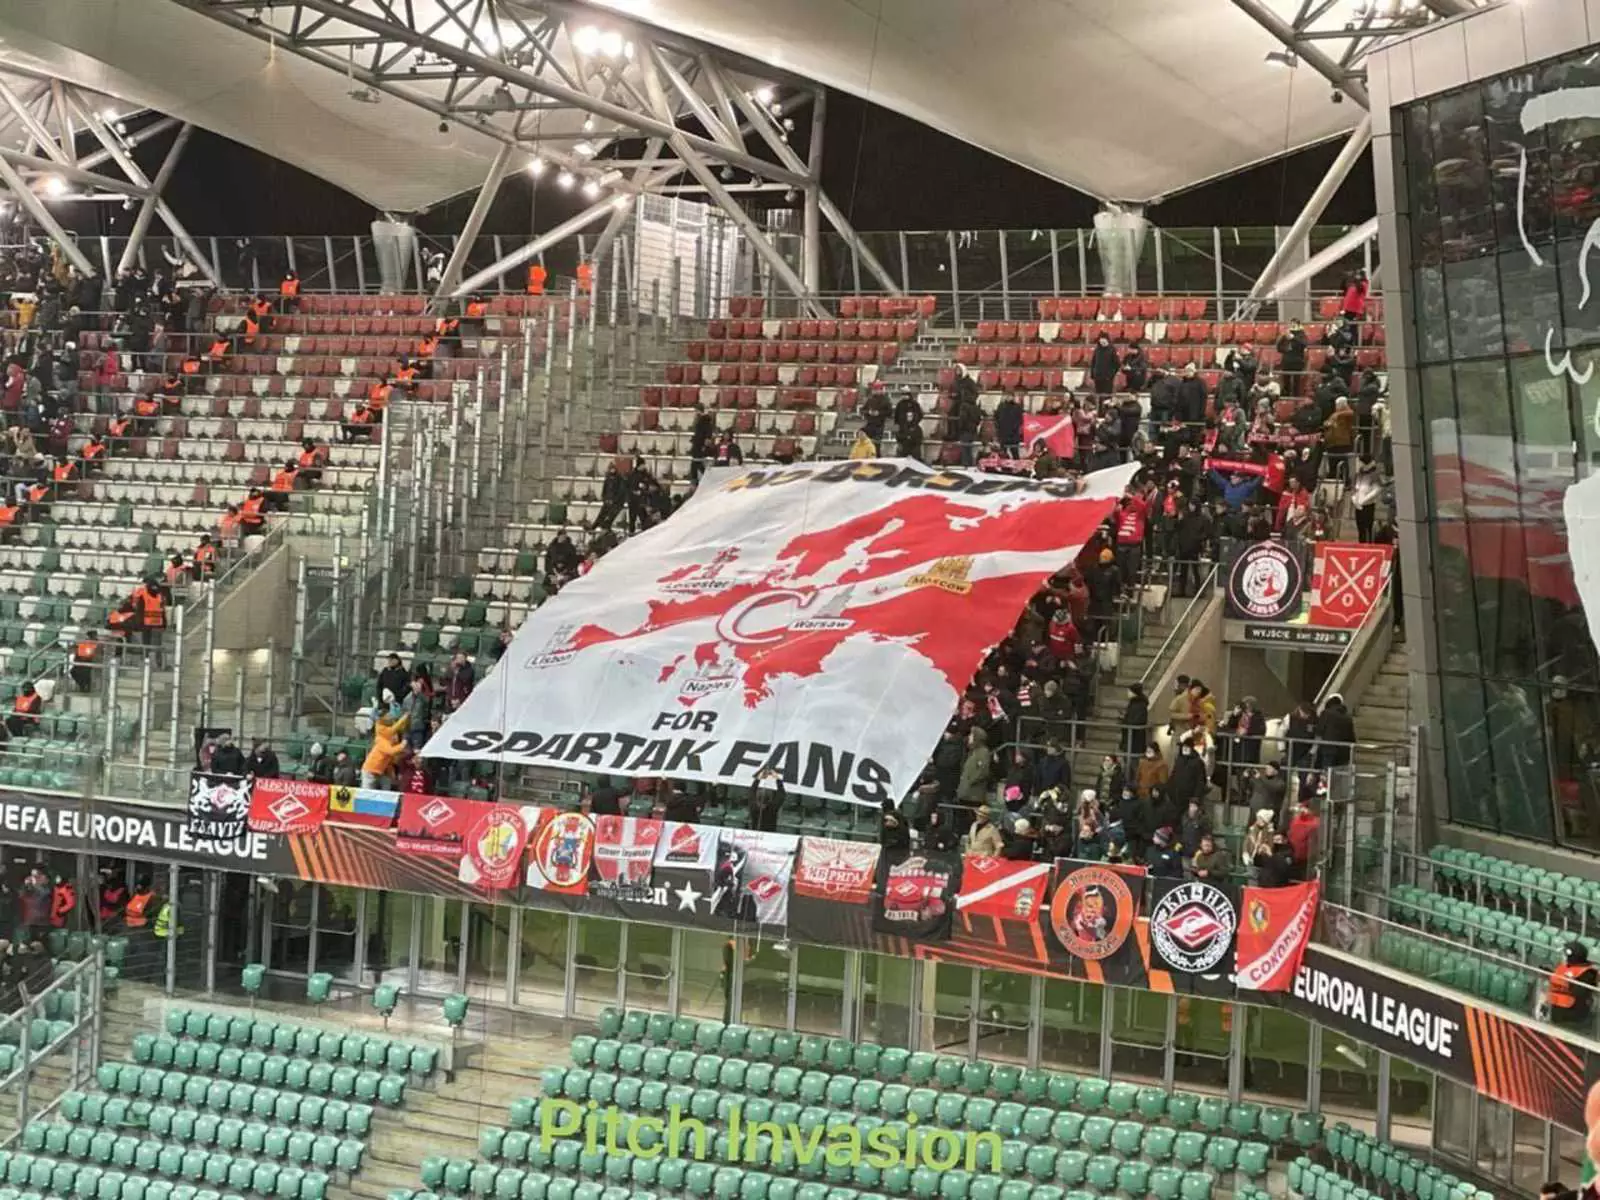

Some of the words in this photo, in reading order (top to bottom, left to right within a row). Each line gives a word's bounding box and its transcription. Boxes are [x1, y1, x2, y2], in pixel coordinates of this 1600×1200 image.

[794, 619, 849, 630] Warsaw
[530, 652, 574, 667] Lisbon
[686, 679, 733, 693] Naples
[652, 710, 719, 733] FOR
[450, 730, 722, 774] SPARTAK
[718, 740, 893, 804] FANS
[58, 811, 157, 848] EUROPA
[1294, 967, 1368, 1024] EUROPA
[1371, 992, 1453, 1058] LEAGUE
